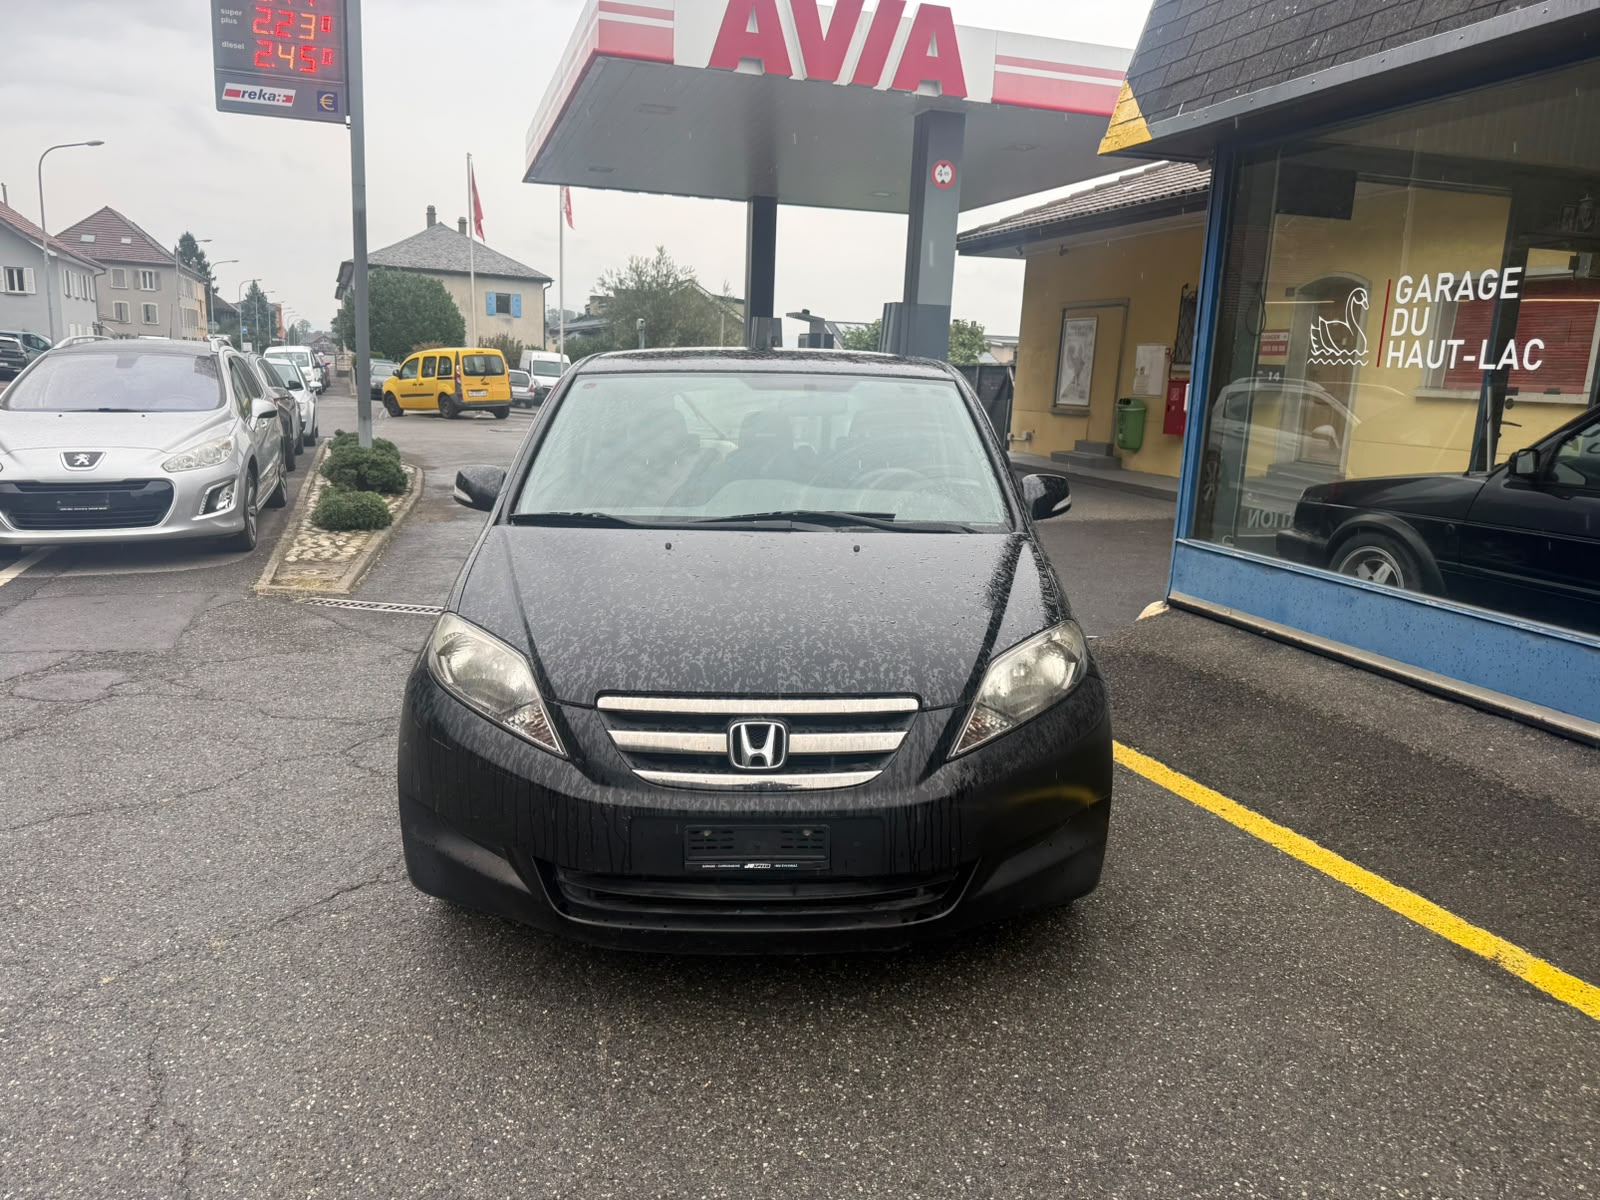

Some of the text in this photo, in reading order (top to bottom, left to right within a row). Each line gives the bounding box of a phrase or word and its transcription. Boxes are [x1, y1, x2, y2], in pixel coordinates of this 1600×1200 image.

[220, 7, 242, 16] super
[220, 16, 238, 25] plus
[221, 40, 245, 50] diesel
[708, 0, 968, 98] AVIA
[1395, 266, 1522, 304] GARAGE
[1390, 307, 1430, 337] DU
[1386, 338, 1545, 371] HAUT-LAC
